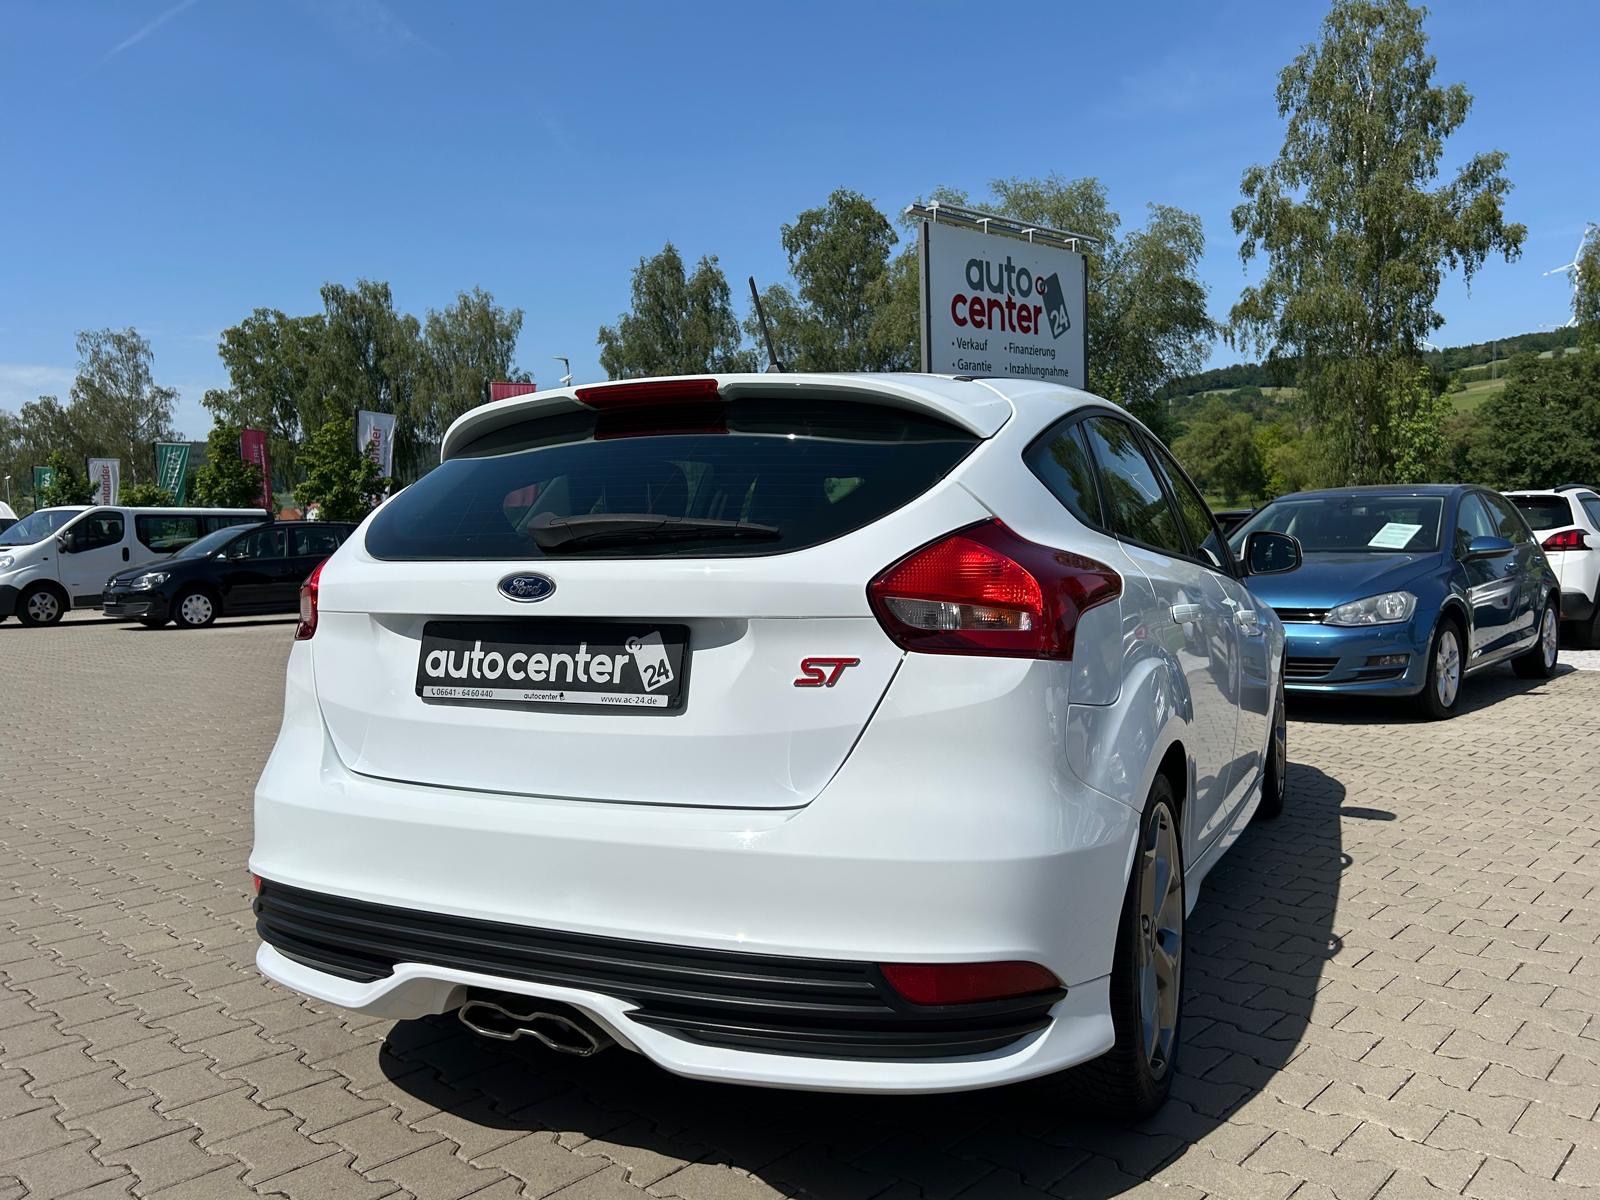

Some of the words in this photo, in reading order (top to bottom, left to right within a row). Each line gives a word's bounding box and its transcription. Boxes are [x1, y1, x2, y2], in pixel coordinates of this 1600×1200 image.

[965, 256, 1033, 298] auto
[951, 293, 1043, 336] center
[1050, 304, 1070, 334] 24
[956, 337, 989, 352] Verkauf
[1008, 342, 1056, 360] Finanzierung
[957, 358, 992, 373] Garantie
[1009, 362, 1070, 379] Inzahlungnahme
[509, 577, 542, 595] Ford
[425, 640, 629, 684] autocenter
[643, 658, 670, 689] 24
[793, 657, 861, 688] ST
[436, 687, 457, 697] 06641
[523, 692, 559, 701] autocenter
[600, 696, 658, 706] www.ac-24.de
